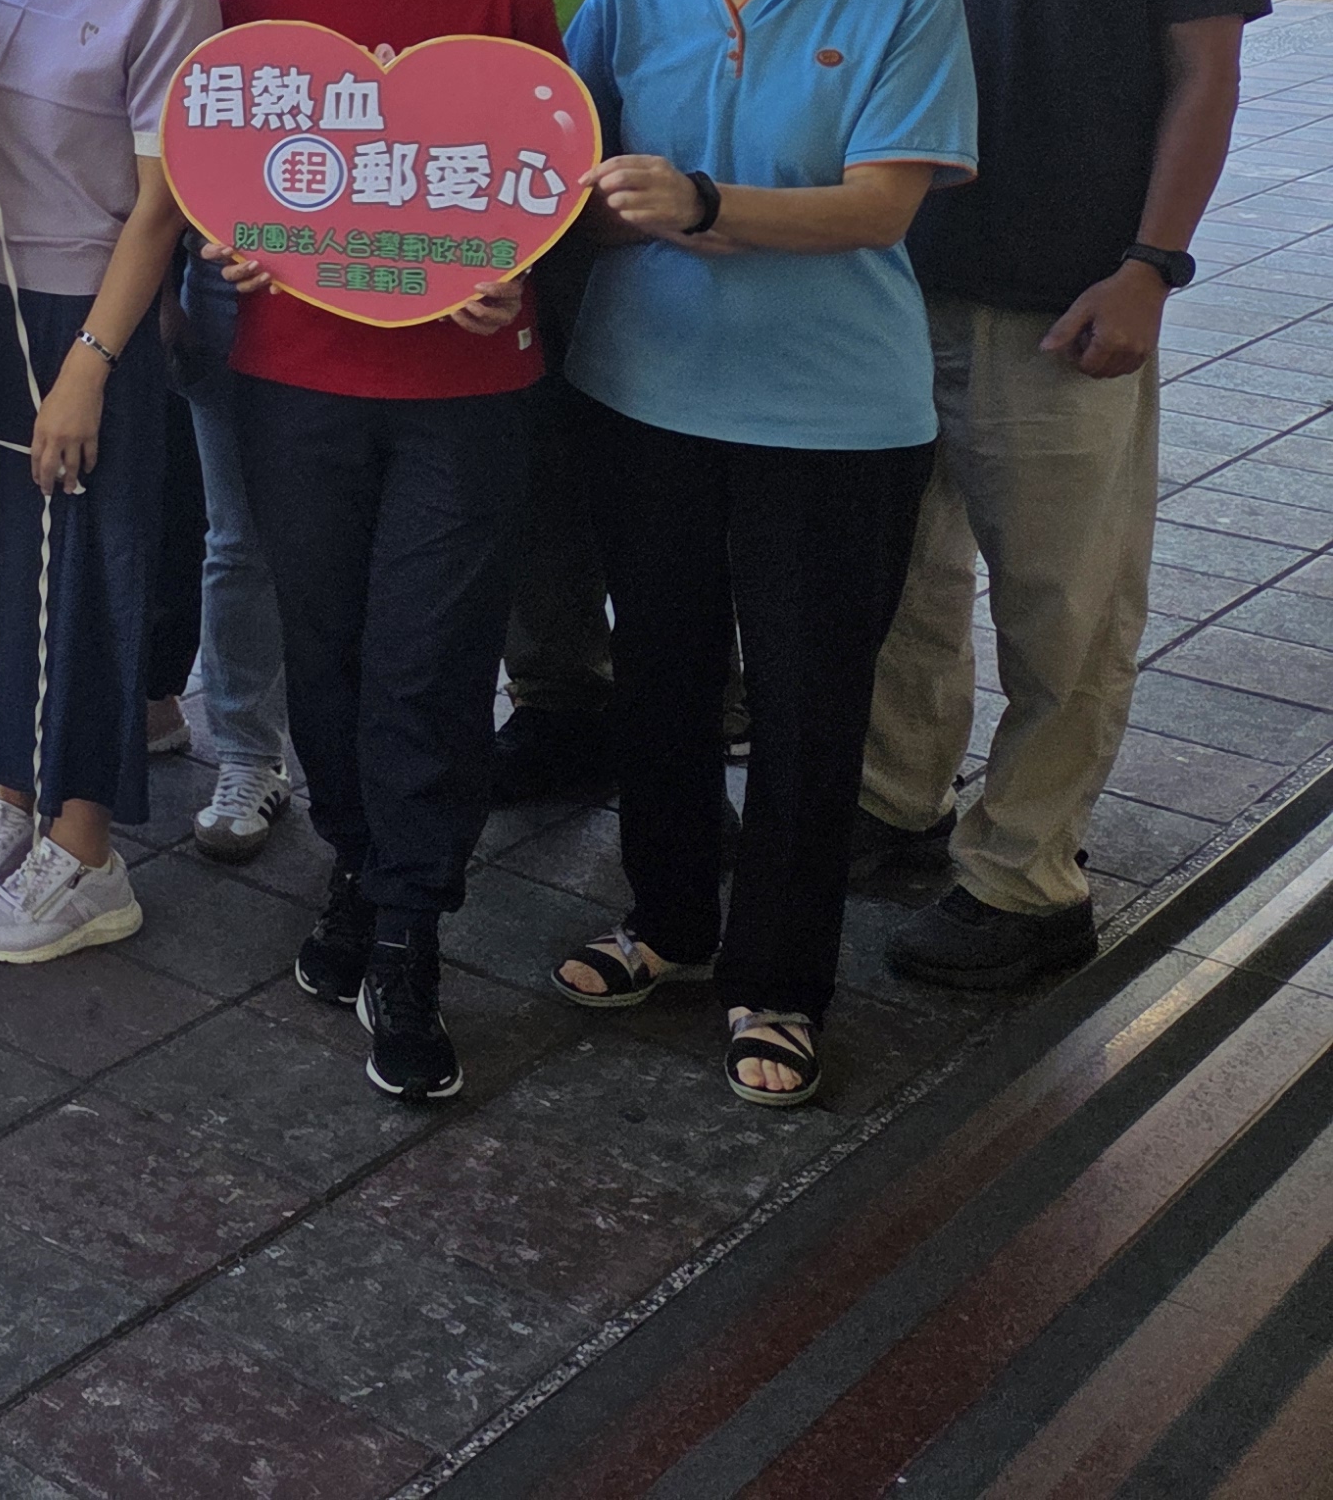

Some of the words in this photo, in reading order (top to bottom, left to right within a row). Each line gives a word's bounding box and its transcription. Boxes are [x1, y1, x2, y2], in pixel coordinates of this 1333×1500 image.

[183, 64, 385, 133] 捐熱血
[350, 140, 567, 216] 郵愛心
[234, 222, 519, 271] 財團法人台灣郵政協會
[316, 262, 428, 296] 三重郵局
